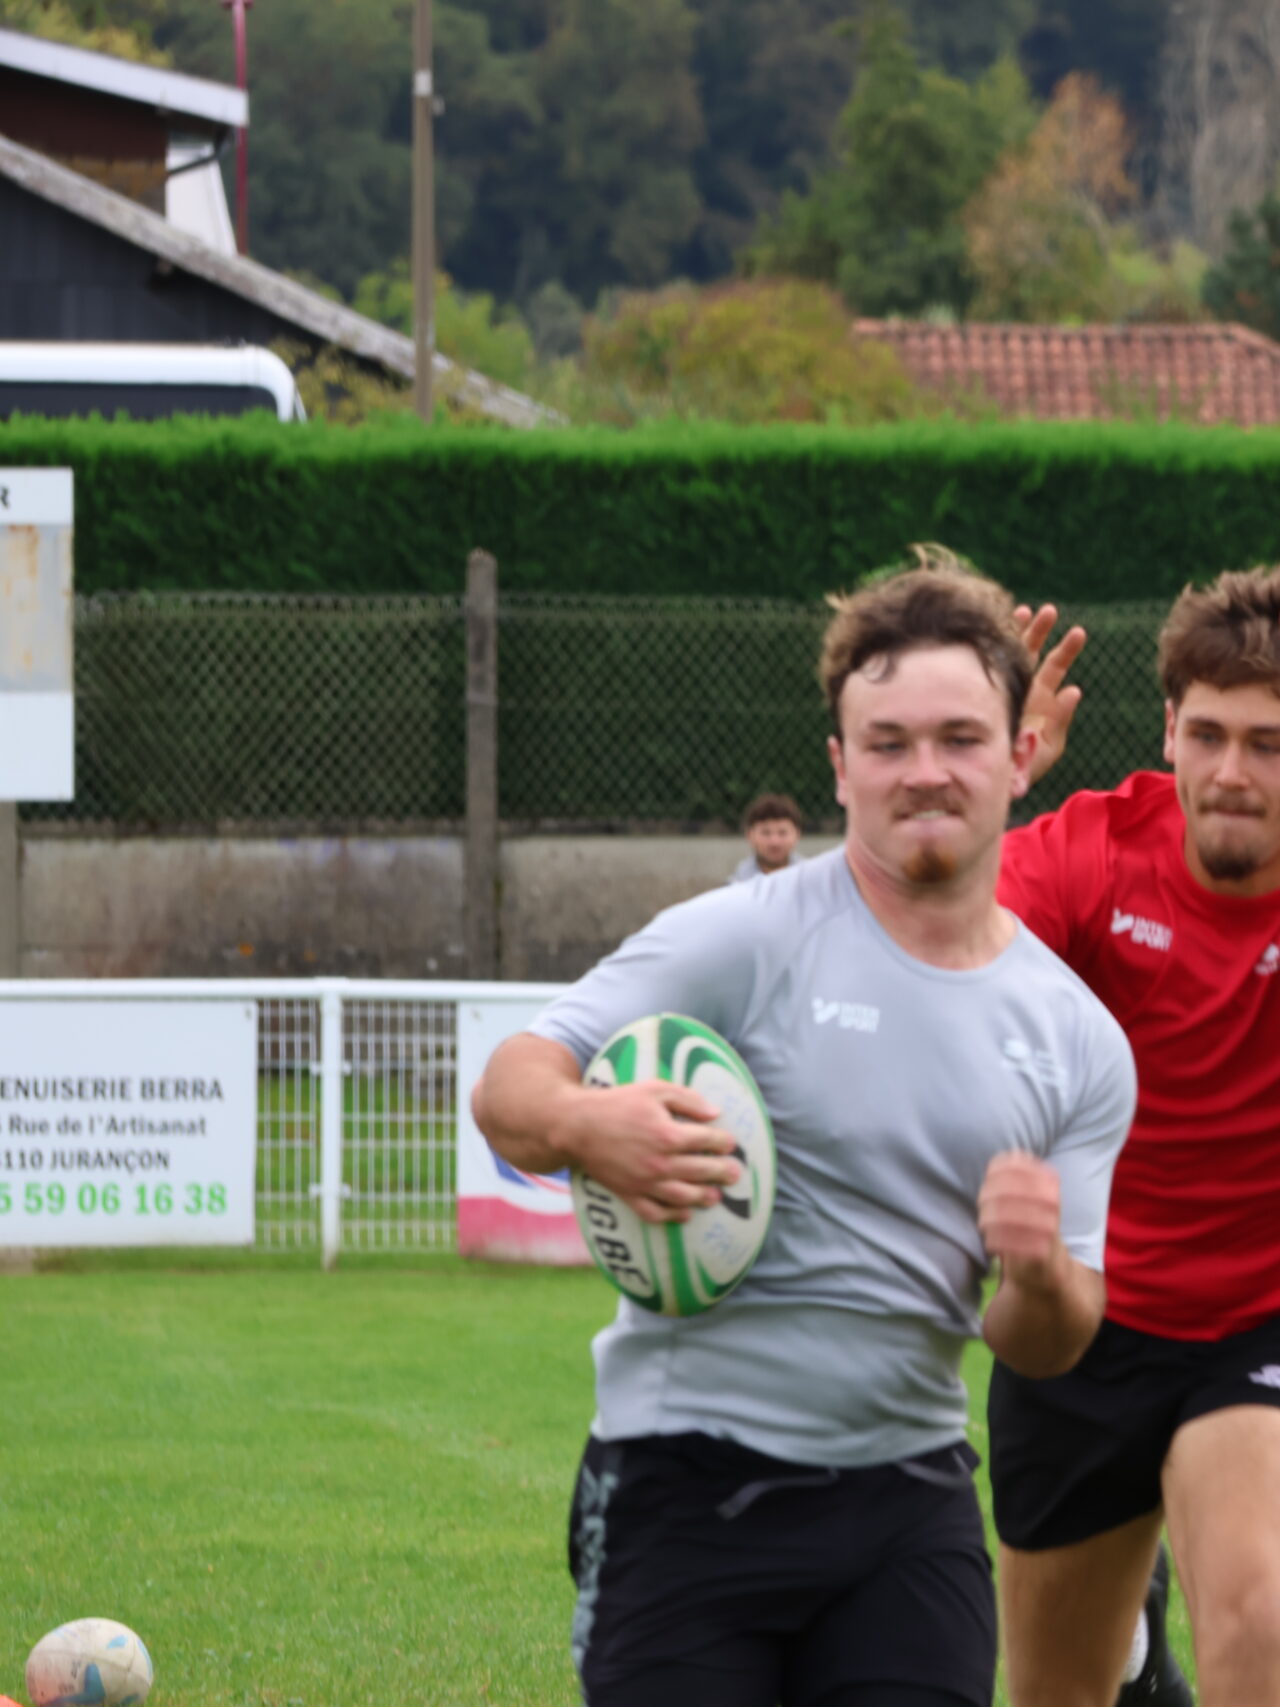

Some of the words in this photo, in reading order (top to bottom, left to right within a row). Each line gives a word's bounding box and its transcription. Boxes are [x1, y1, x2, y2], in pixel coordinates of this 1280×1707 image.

[140, 1078, 224, 1100] BERRA
[9, 1114, 49, 1135] Rue
[57, 1116, 82, 1135] de
[89, 1115, 207, 1136] l'Artisanat
[0, 1150, 43, 1170] 110
[49, 1150, 170, 1176] JURANÇON
[24, 1183, 66, 1215] 59
[77, 1183, 121, 1215] 06
[135, 1183, 174, 1215] 16
[184, 1183, 227, 1215] 38
